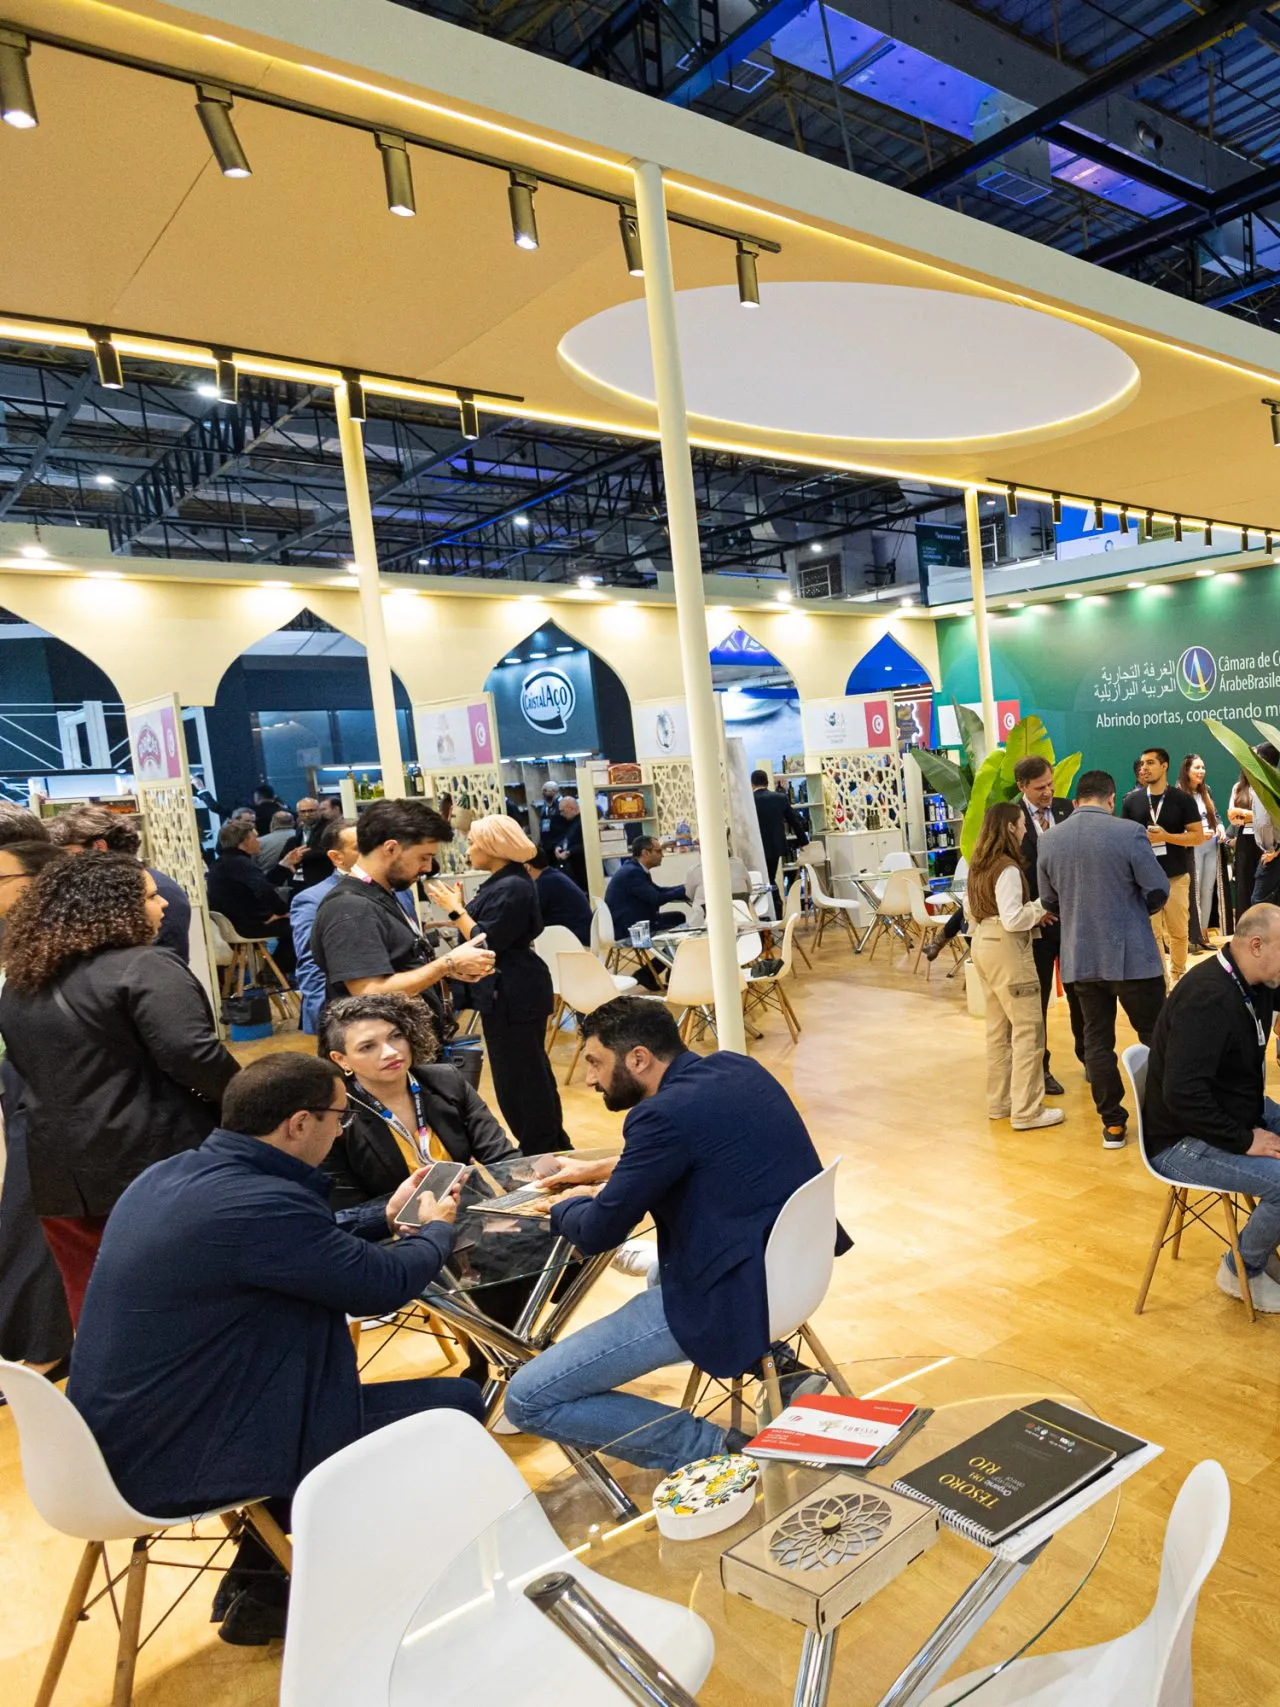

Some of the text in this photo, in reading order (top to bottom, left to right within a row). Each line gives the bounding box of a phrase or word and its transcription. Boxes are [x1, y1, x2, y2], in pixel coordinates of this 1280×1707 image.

[1101, 659, 1175, 685] الغرفة التجارية
[1218, 655, 1256, 672] Câmara
[1258, 652, 1271, 668] de
[1094, 677, 1177, 702] العربية البرازيلية
[1096, 712, 1141, 729] Abrindo
[1143, 709, 1184, 729] portas,
[1186, 703, 1262, 722] conectando
[968, 1456, 1002, 1475] RIO
[938, 1473, 1000, 1510] TESORO
